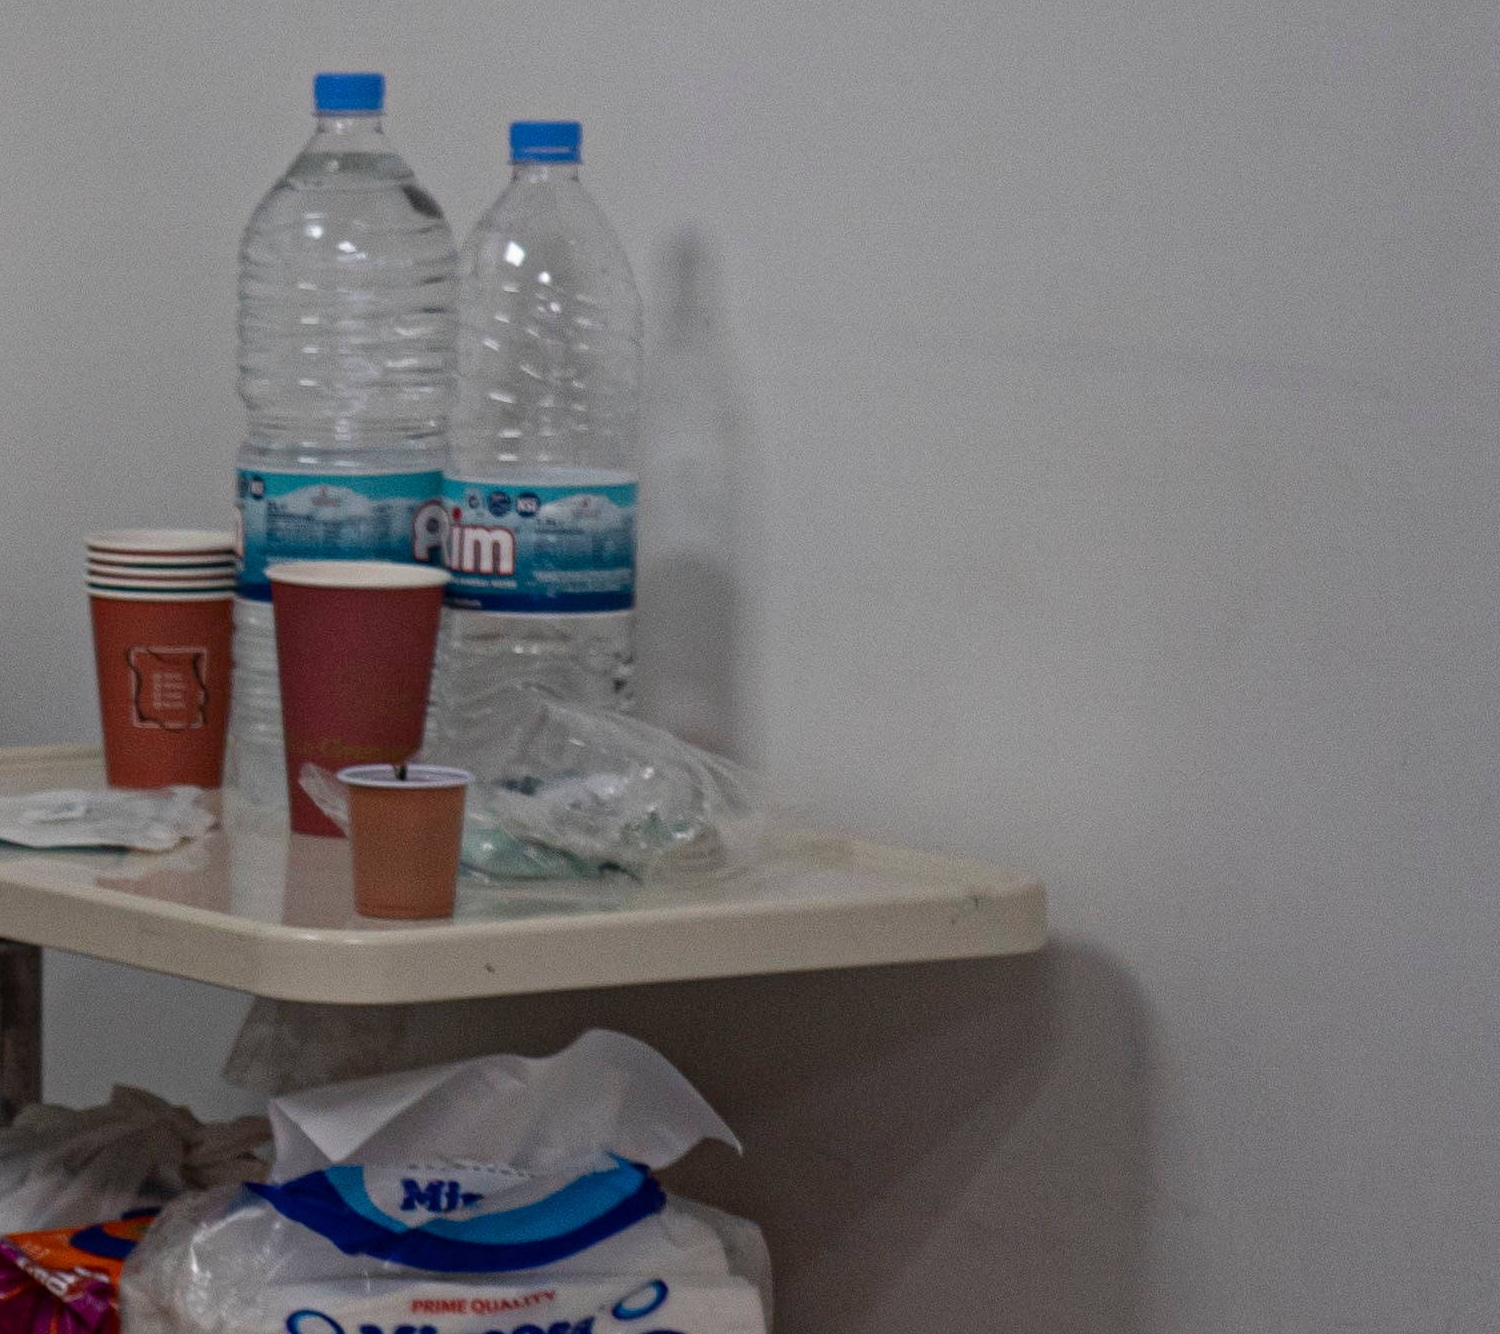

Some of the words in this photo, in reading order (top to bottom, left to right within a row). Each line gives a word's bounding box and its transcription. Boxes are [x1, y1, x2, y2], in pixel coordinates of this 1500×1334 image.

[399, 1178, 485, 1213] Mi
[410, 1297, 468, 1316] PRIME
[469, 1290, 557, 1315] QUALITY
